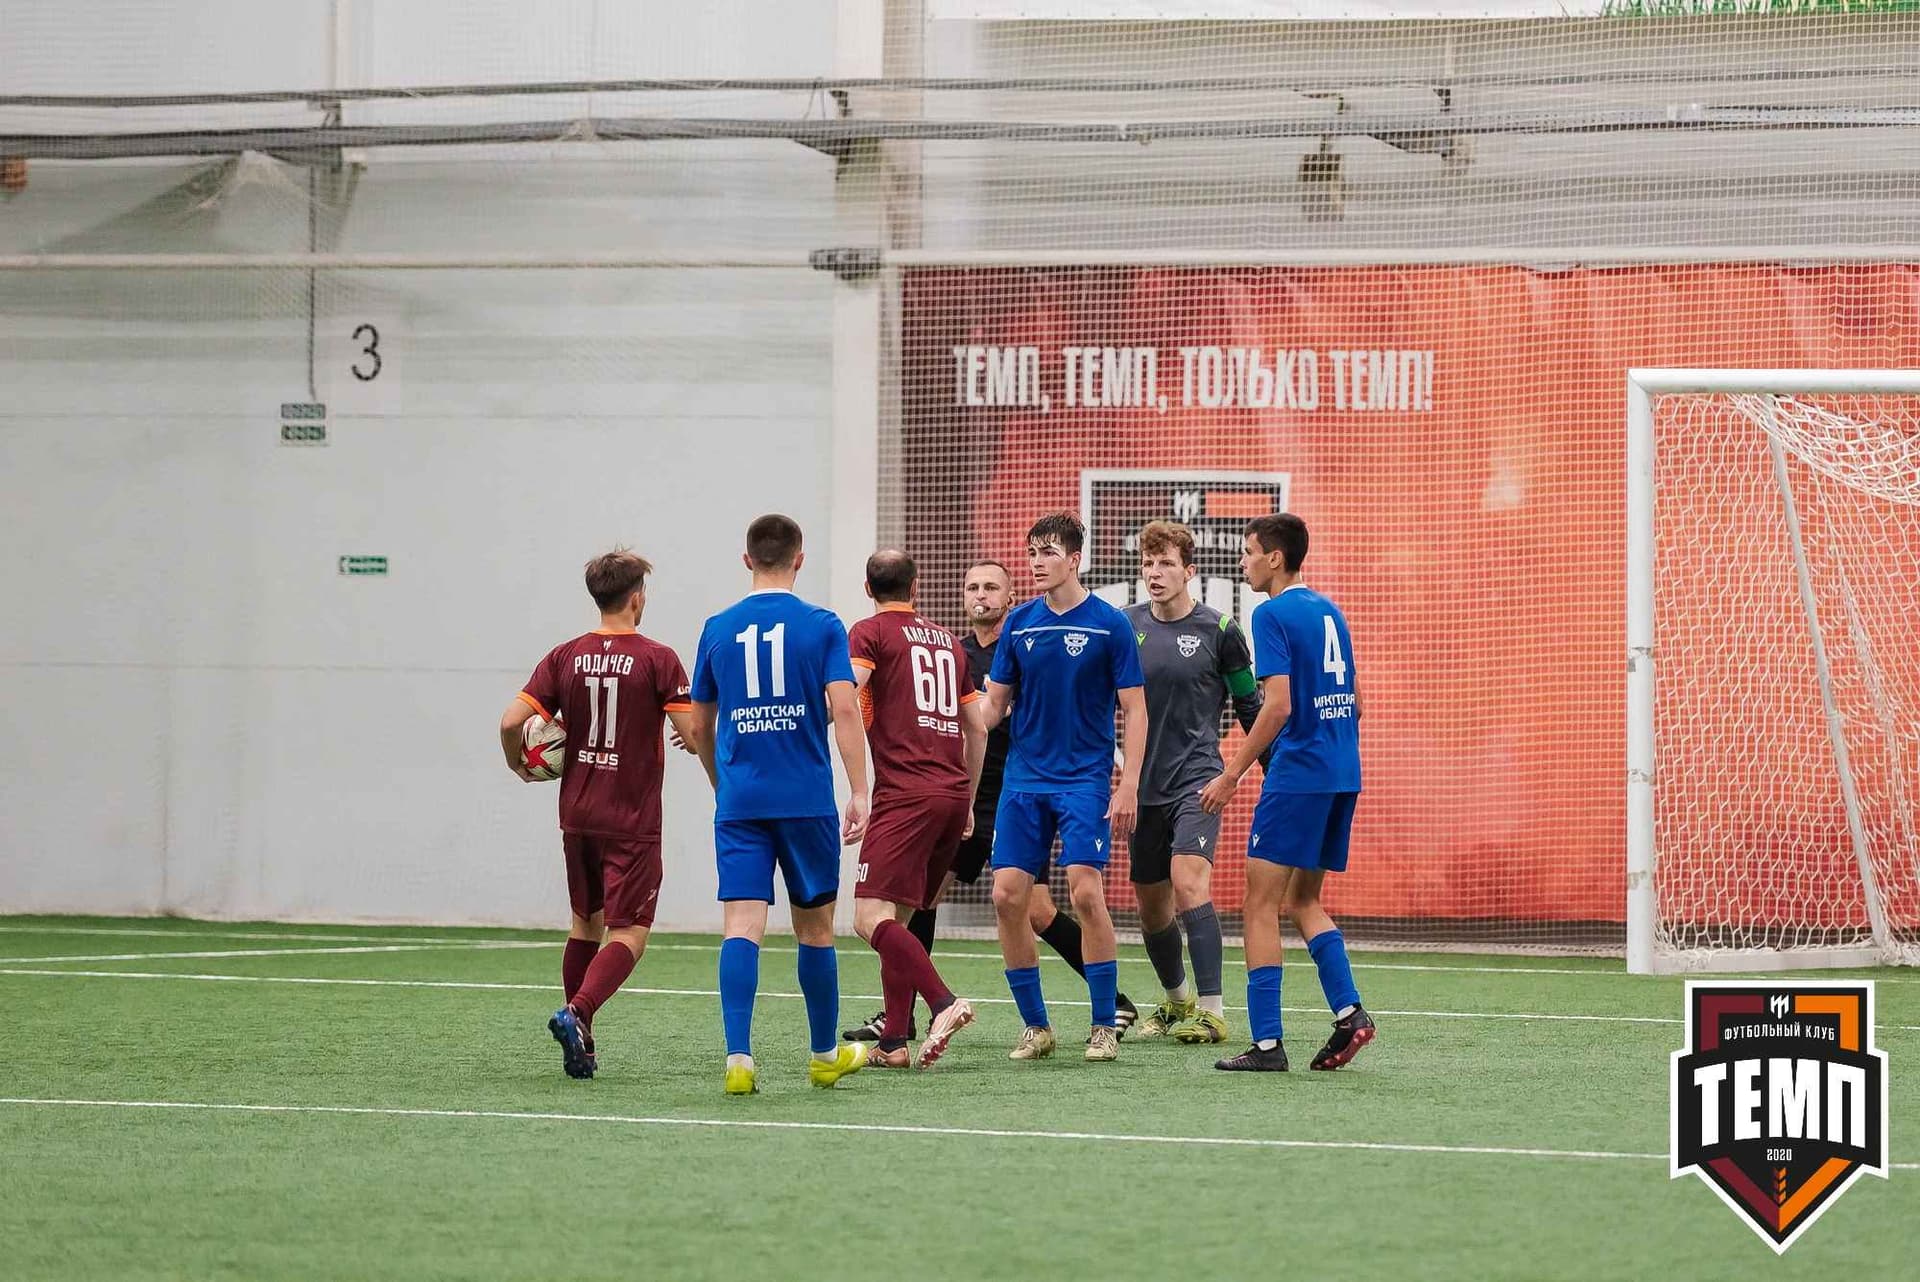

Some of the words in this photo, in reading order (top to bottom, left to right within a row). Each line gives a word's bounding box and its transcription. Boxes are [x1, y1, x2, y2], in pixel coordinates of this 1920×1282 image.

[351, 323, 382, 381] 3
[953, 345, 1051, 413] ТЕМП,
[1062, 346, 1169, 415] ТЕМП,
[1179, 347, 1318, 410] ТОЛЬКО
[1329, 349, 1435, 411] ТЕМП!
[902, 625, 953, 649] КИСЕЛЕВ
[1323, 615, 1346, 685] 4
[574, 654, 634, 675] РОДИЧЕВ
[736, 623, 785, 698] 11
[911, 645, 958, 717] 60
[584, 676, 619, 748] 11
[731, 704, 805, 721] ИРКУТСКАЯ
[737, 718, 797, 734] ОБЛАСТЬ
[918, 715, 959, 733] SEUS
[578, 750, 619, 766] SEUS
